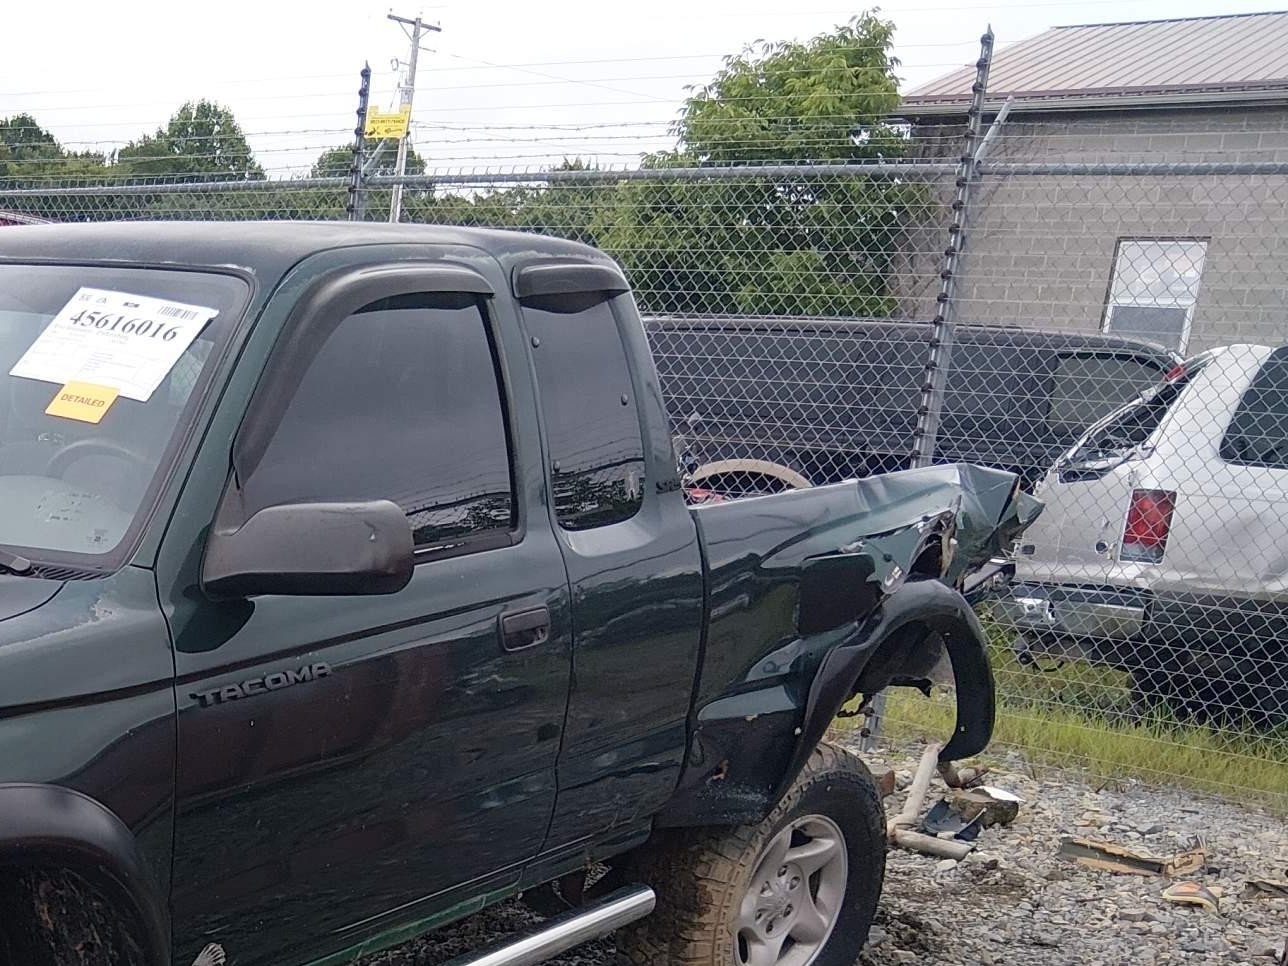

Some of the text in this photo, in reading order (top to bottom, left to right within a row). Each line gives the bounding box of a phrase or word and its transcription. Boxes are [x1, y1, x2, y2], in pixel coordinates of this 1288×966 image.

[70, 309, 183, 341] 45616016
[60, 393, 106, 409] DETAILED
[190, 662, 331, 705] TACOMA
